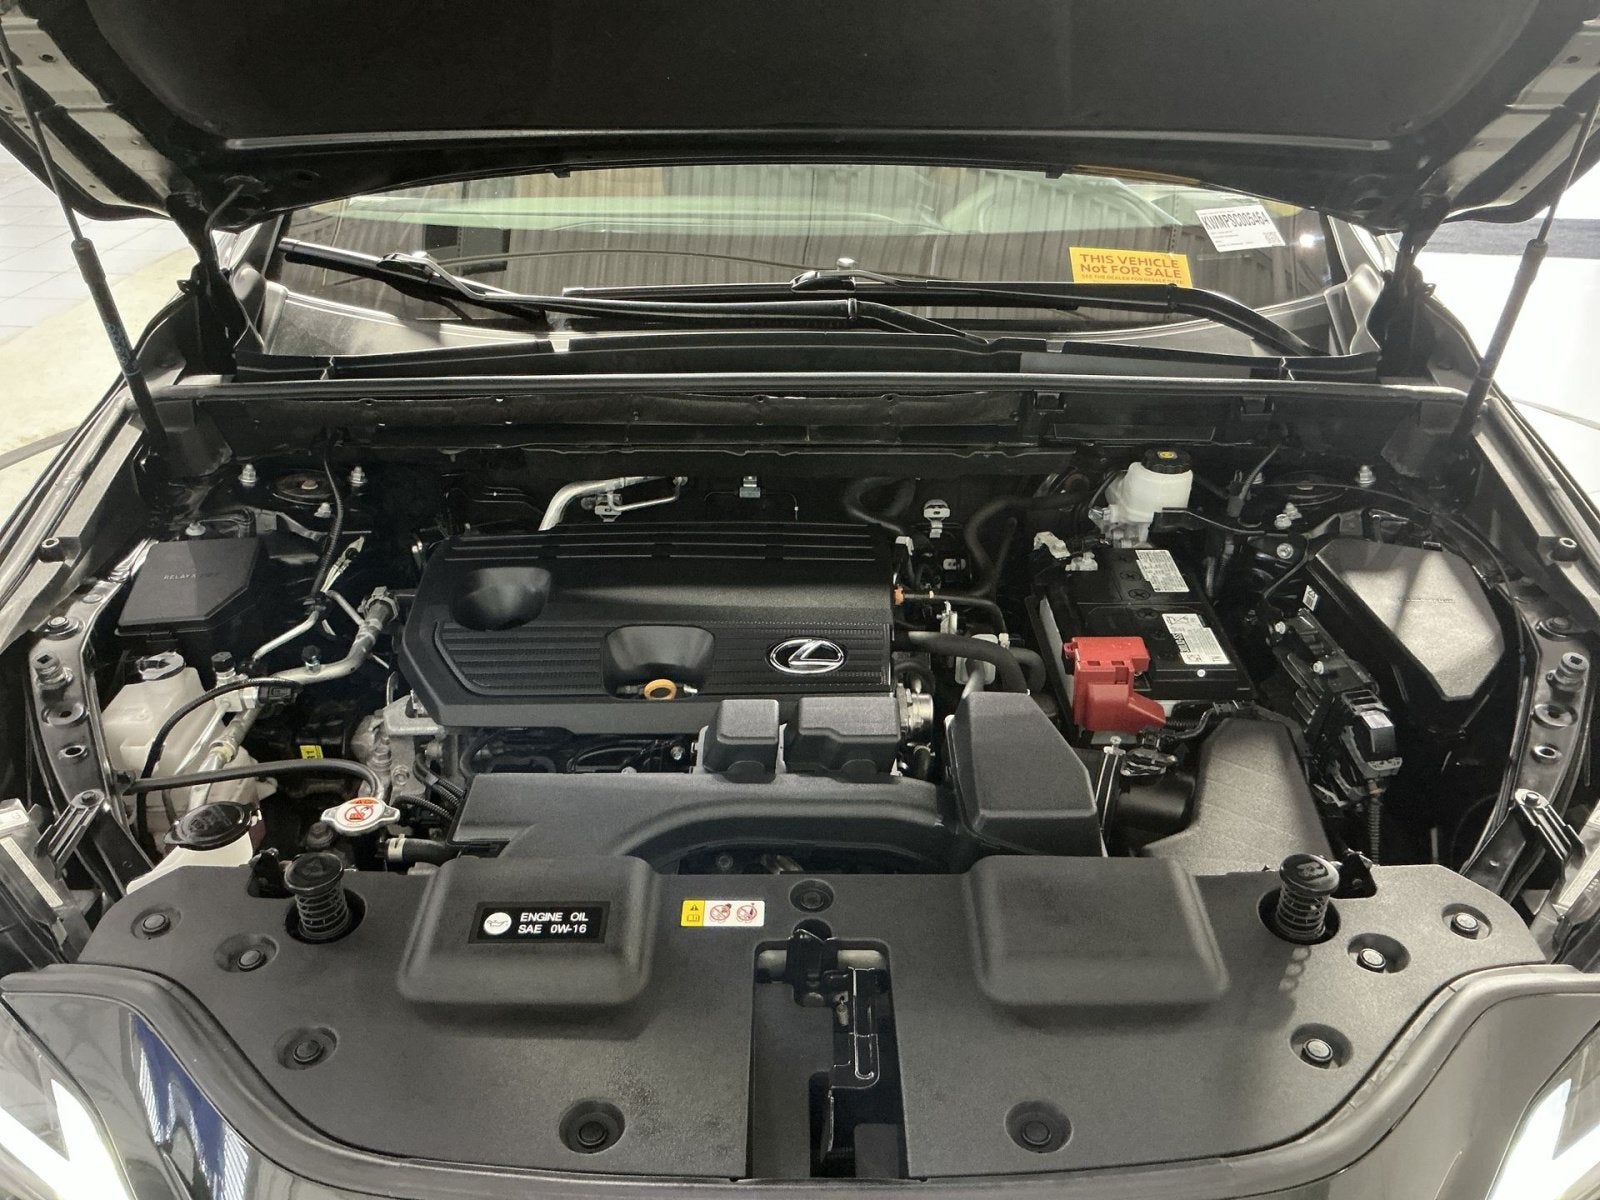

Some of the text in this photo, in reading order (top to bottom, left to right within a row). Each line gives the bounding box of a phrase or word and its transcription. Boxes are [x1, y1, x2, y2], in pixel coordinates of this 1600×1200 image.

[1080, 253, 1180, 268] THIS VEHICLE
[1080, 264, 1183, 279] Not FOR SALE
[520, 912, 589, 922] ENGINE OIL
[518, 923, 587, 934] SAE 0W-16
